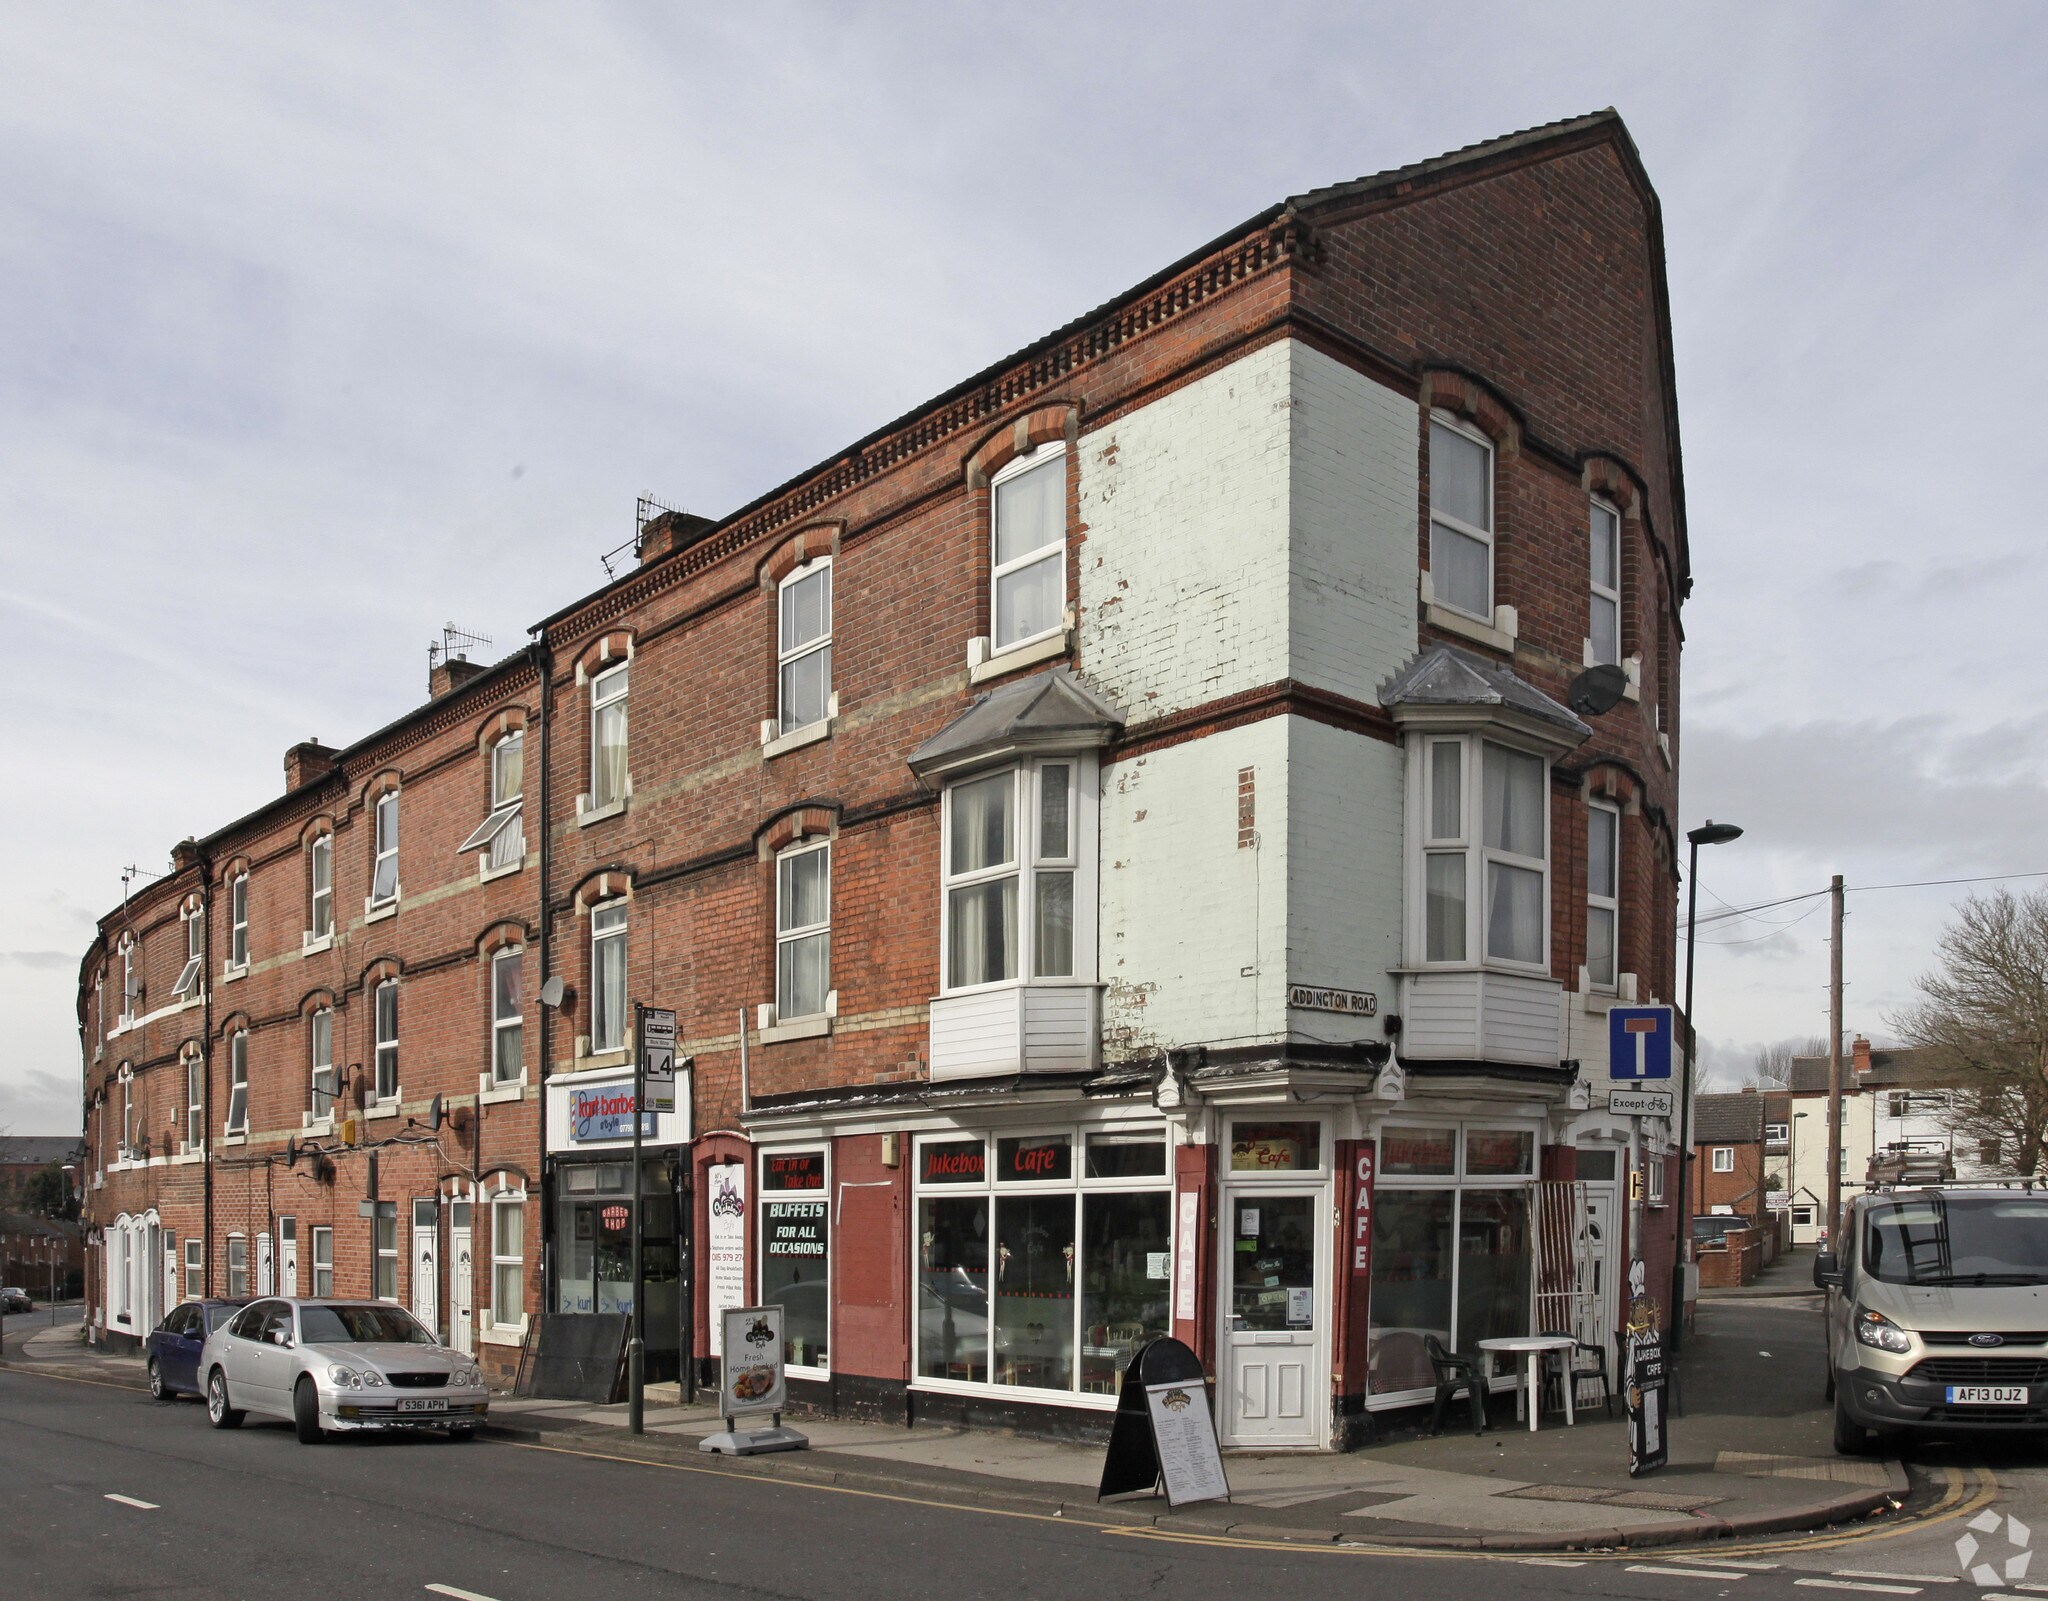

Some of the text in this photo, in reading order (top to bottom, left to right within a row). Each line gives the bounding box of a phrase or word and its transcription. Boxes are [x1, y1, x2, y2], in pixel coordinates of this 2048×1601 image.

[1292, 989, 1376, 1011] ADDINGTON ROAD
[647, 1054, 672, 1076] L4
[578, 1092, 636, 1118] kurt barbe
[1613, 1098, 1645, 1110] Except
[600, 1117, 619, 1132] style
[924, 1146, 1055, 1179] Jukebox Cafe
[1256, 1147, 1291, 1169] Cafe
[770, 1159, 786, 1172] Eat
[787, 1159, 798, 1171] In
[784, 1173, 822, 1189] Take Out
[602, 1206, 629, 1218] BARBER
[769, 1203, 825, 1218] BUFFETS
[1355, 1157, 1371, 1269] CAFE
[605, 1218, 626, 1230] SHOP
[776, 1226, 817, 1238] FOR ALL
[769, 1242, 825, 1255] OCCASIONS
[722, 1253, 733, 1262] 979
[1180, 1200, 1195, 1312] CAFE
[577, 1295, 633, 1313] kurt kurt
[1261, 1292, 1284, 1303] OPEN
[1976, 1335, 1996, 1343] Ford
[744, 1353, 764, 1362] Fresh
[730, 1361, 778, 1374] Home Cooked
[1646, 1363, 1662, 1376] CAFE
[1959, 1388, 2022, 1401] AF13 OJZ
[405, 1400, 445, 1410] S361 APH
